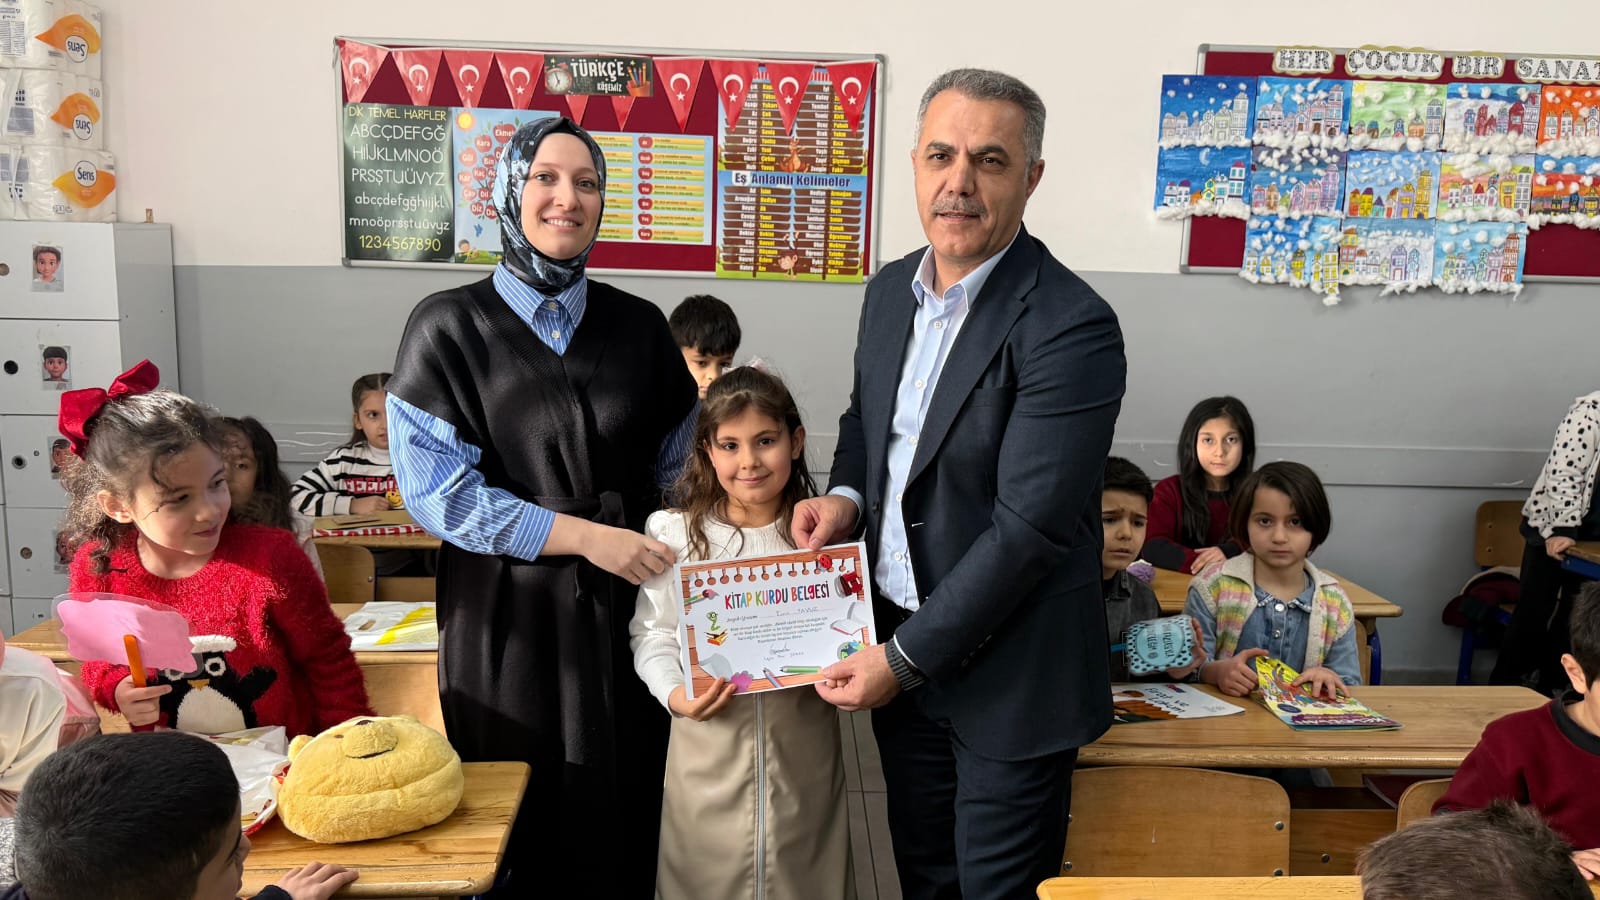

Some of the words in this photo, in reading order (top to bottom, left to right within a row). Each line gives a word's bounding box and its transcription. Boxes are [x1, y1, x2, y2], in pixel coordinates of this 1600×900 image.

[67, 39, 86, 58] Sens
[570, 58, 625, 82] TÜRKÇE
[1278, 50, 1330, 70] HER
[1348, 50, 1440, 73] ÇOCUK
[368, 107, 400, 119] TEMEL
[404, 109, 447, 121] HARFLER
[75, 118, 91, 135] Sens
[350, 123, 446, 142] ABCÇDEFGĞ
[77, 166, 95, 182] Sens
[735, 172, 747, 185] Eş
[751, 173, 793, 185] Anlamlı
[796, 174, 850, 187] Kelimeler
[359, 235, 442, 252] 1234567890
[724, 591, 753, 610] KİTAP
[755, 588, 788, 607] KURDU
